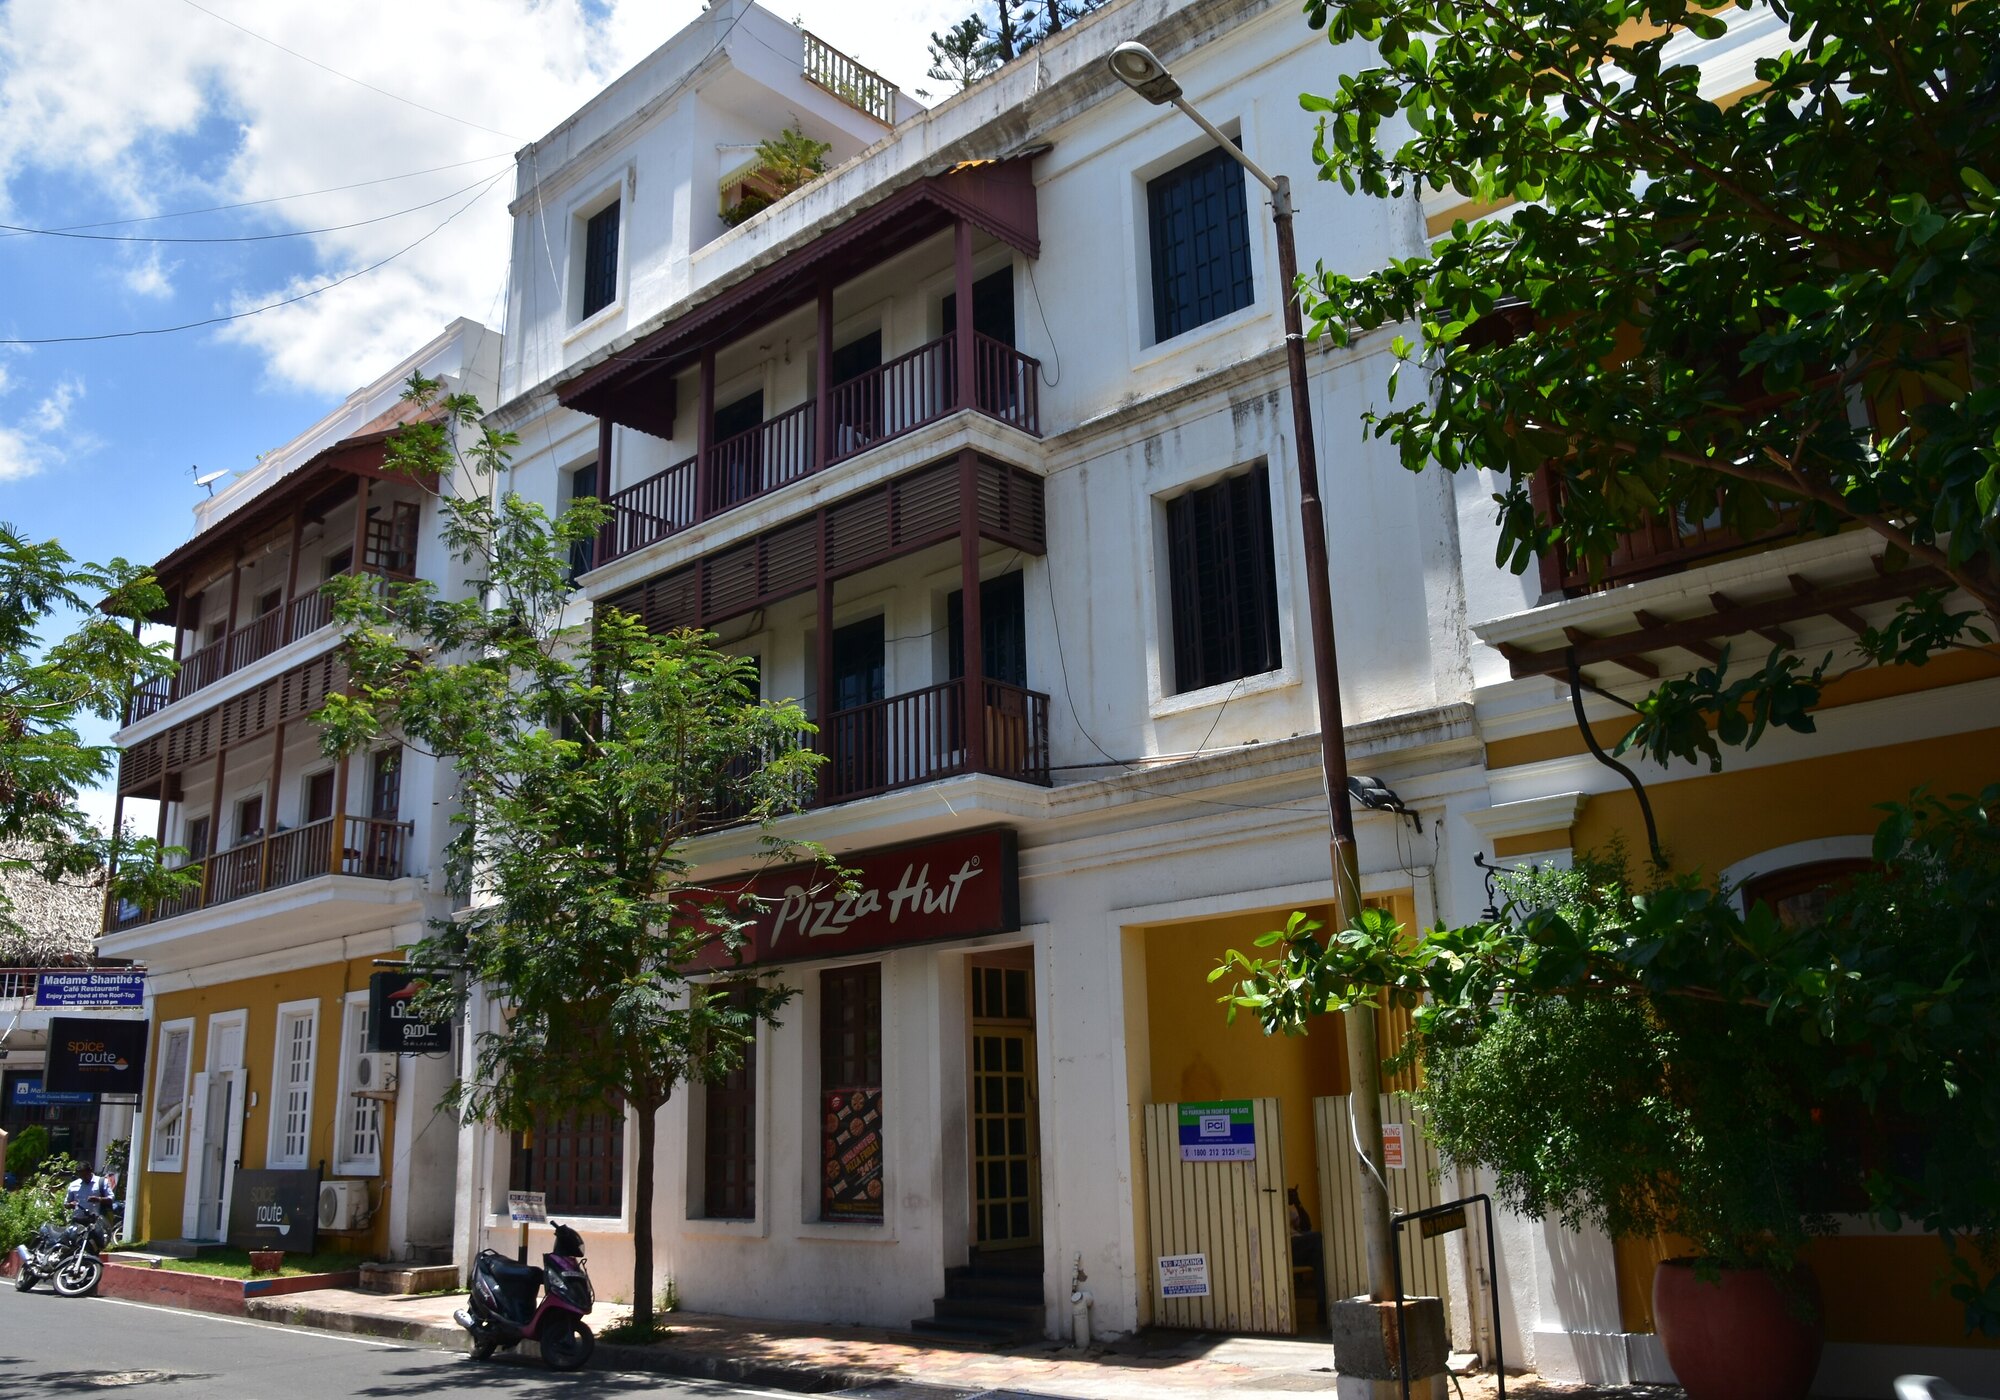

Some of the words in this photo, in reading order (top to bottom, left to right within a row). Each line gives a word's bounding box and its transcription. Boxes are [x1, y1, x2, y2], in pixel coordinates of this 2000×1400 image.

[770, 881, 881, 948] Pizza
[888, 860, 983, 924] Hut
[43, 975, 88, 985] Madame
[67, 1040, 105, 1054] spice
[79, 1051, 117, 1063] route
[1188, 1108, 1206, 1116] PARKING
[1207, 1121, 1223, 1130] PCI
[1383, 1127, 1401, 1137] KING
[1193, 1148, 1207, 1157] 1800
[1208, 1148, 1219, 1156] 212
[1221, 1147, 1236, 1156] 2125
[256, 1202, 283, 1223] route
[1173, 1258, 1202, 1266] PARKING
